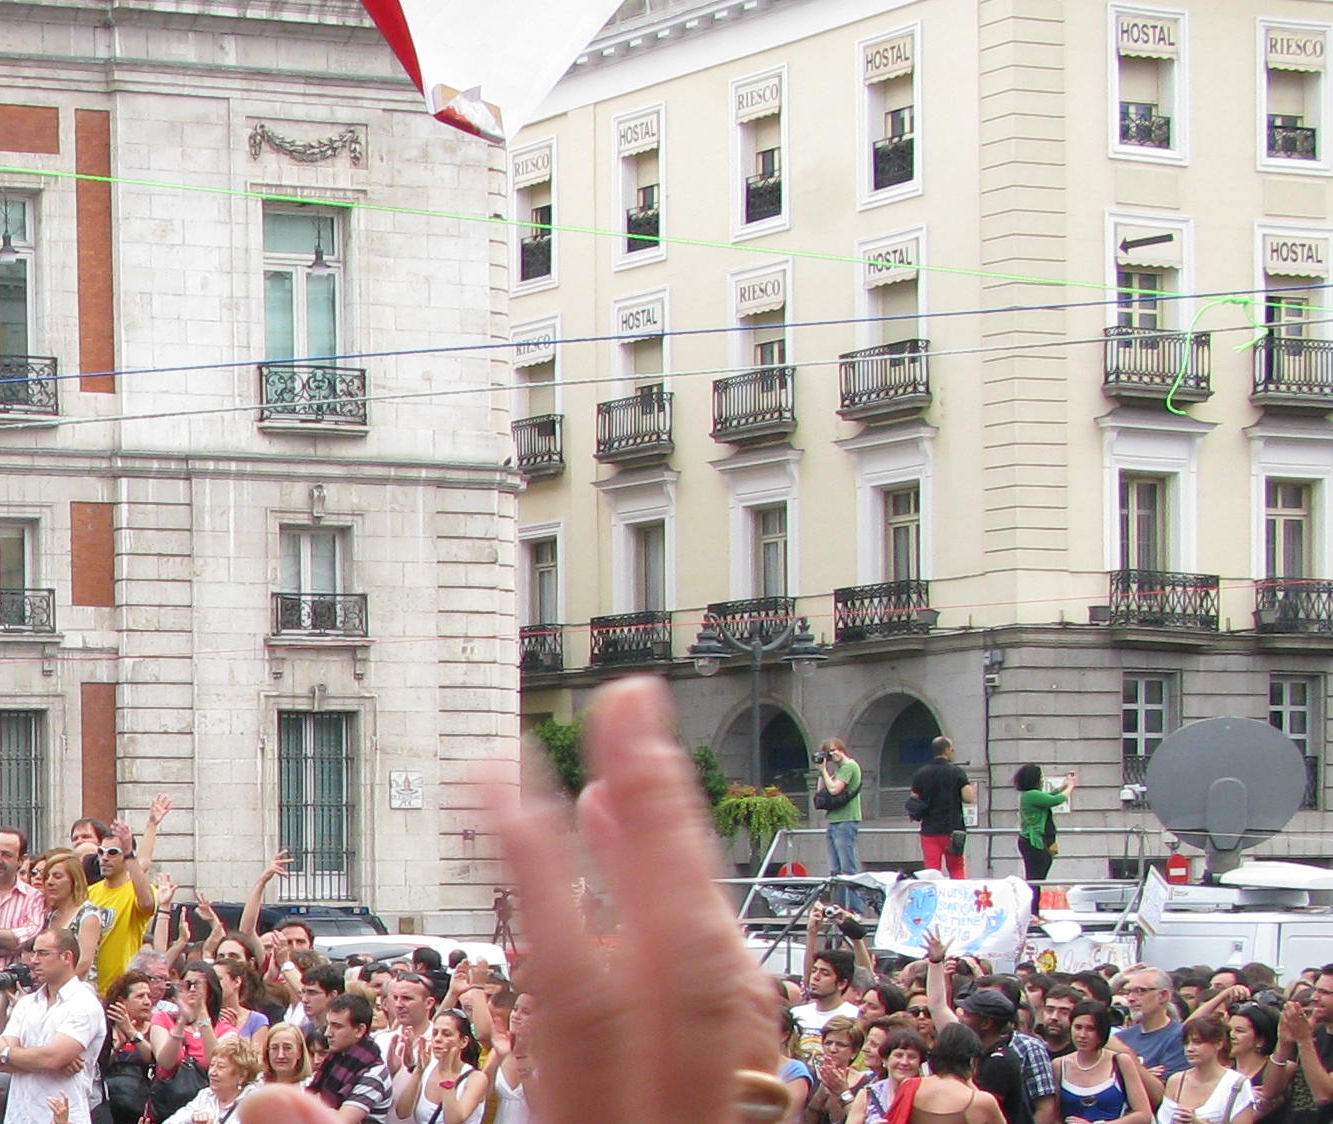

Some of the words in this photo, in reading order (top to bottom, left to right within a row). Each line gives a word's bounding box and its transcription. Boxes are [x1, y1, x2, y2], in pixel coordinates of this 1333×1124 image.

[1120, 22, 1176, 47] HOSTAL
[865, 45, 910, 73] HOSTAL
[1269, 37, 1325, 58] RIESCO
[737, 83, 780, 111] RIESCO
[618, 119, 658, 146] HOSTAL
[514, 152, 550, 178] RIESCO
[868, 247, 913, 275] HOSTAL
[1270, 241, 1323, 264] HOSTAL
[739, 279, 781, 304] RIESCO
[620, 308, 658, 332] HOSTAL
[515, 333, 552, 357] RIESCO
